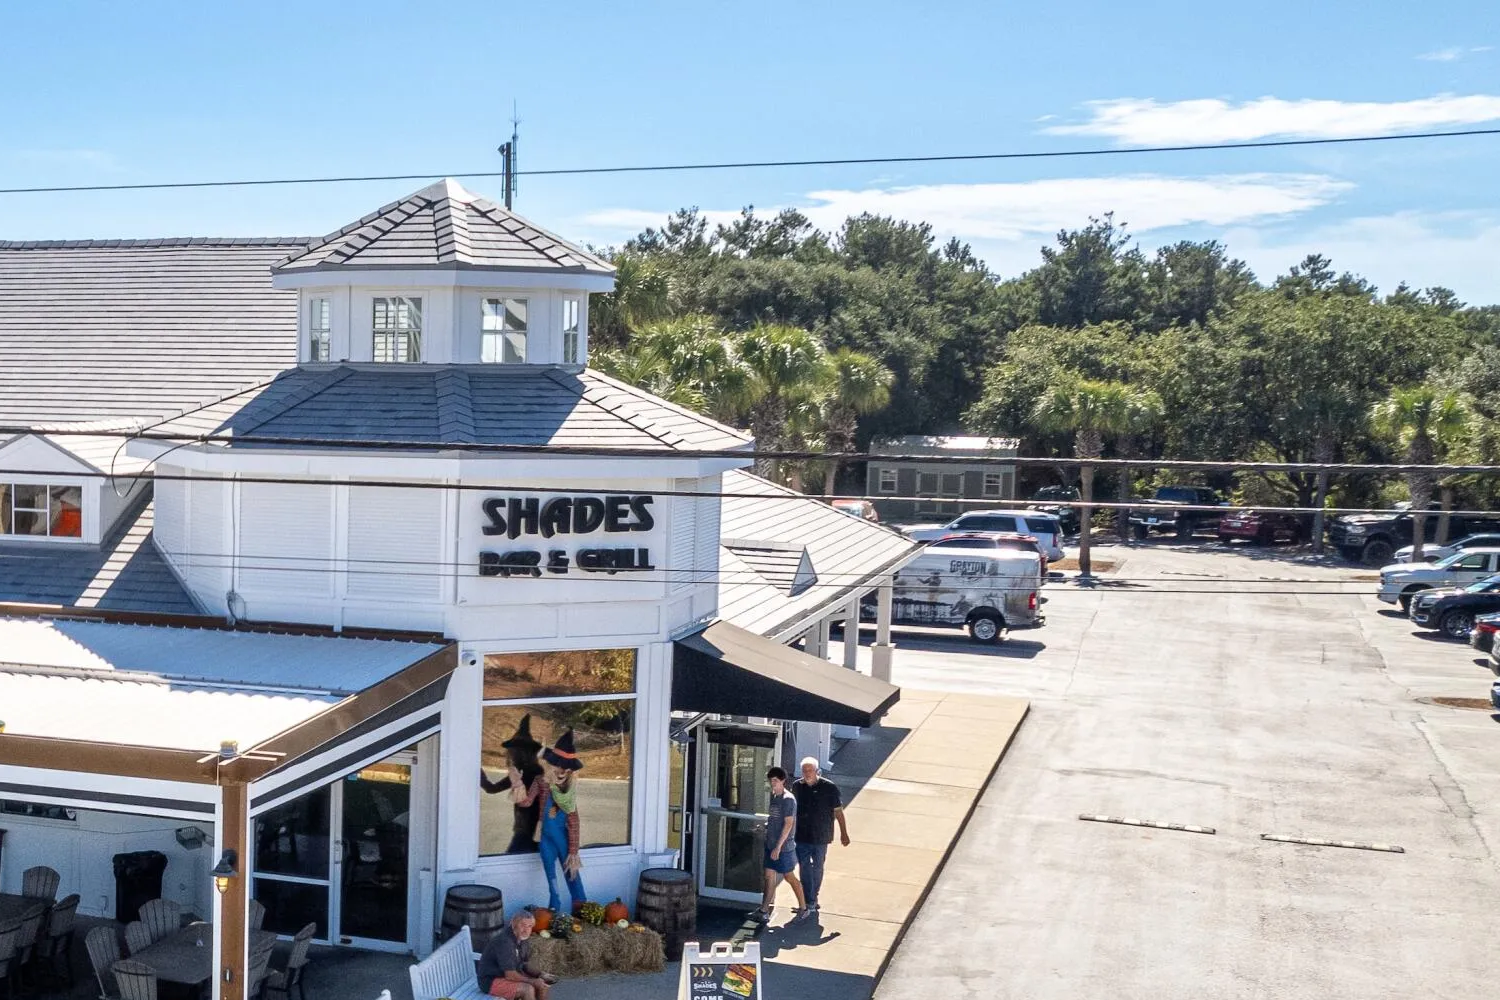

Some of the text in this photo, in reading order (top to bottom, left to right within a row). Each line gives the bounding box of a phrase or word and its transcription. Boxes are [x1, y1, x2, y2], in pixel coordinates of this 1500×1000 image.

[482, 496, 655, 539] SHADES
[479, 548, 655, 578] BAR & GRILL
